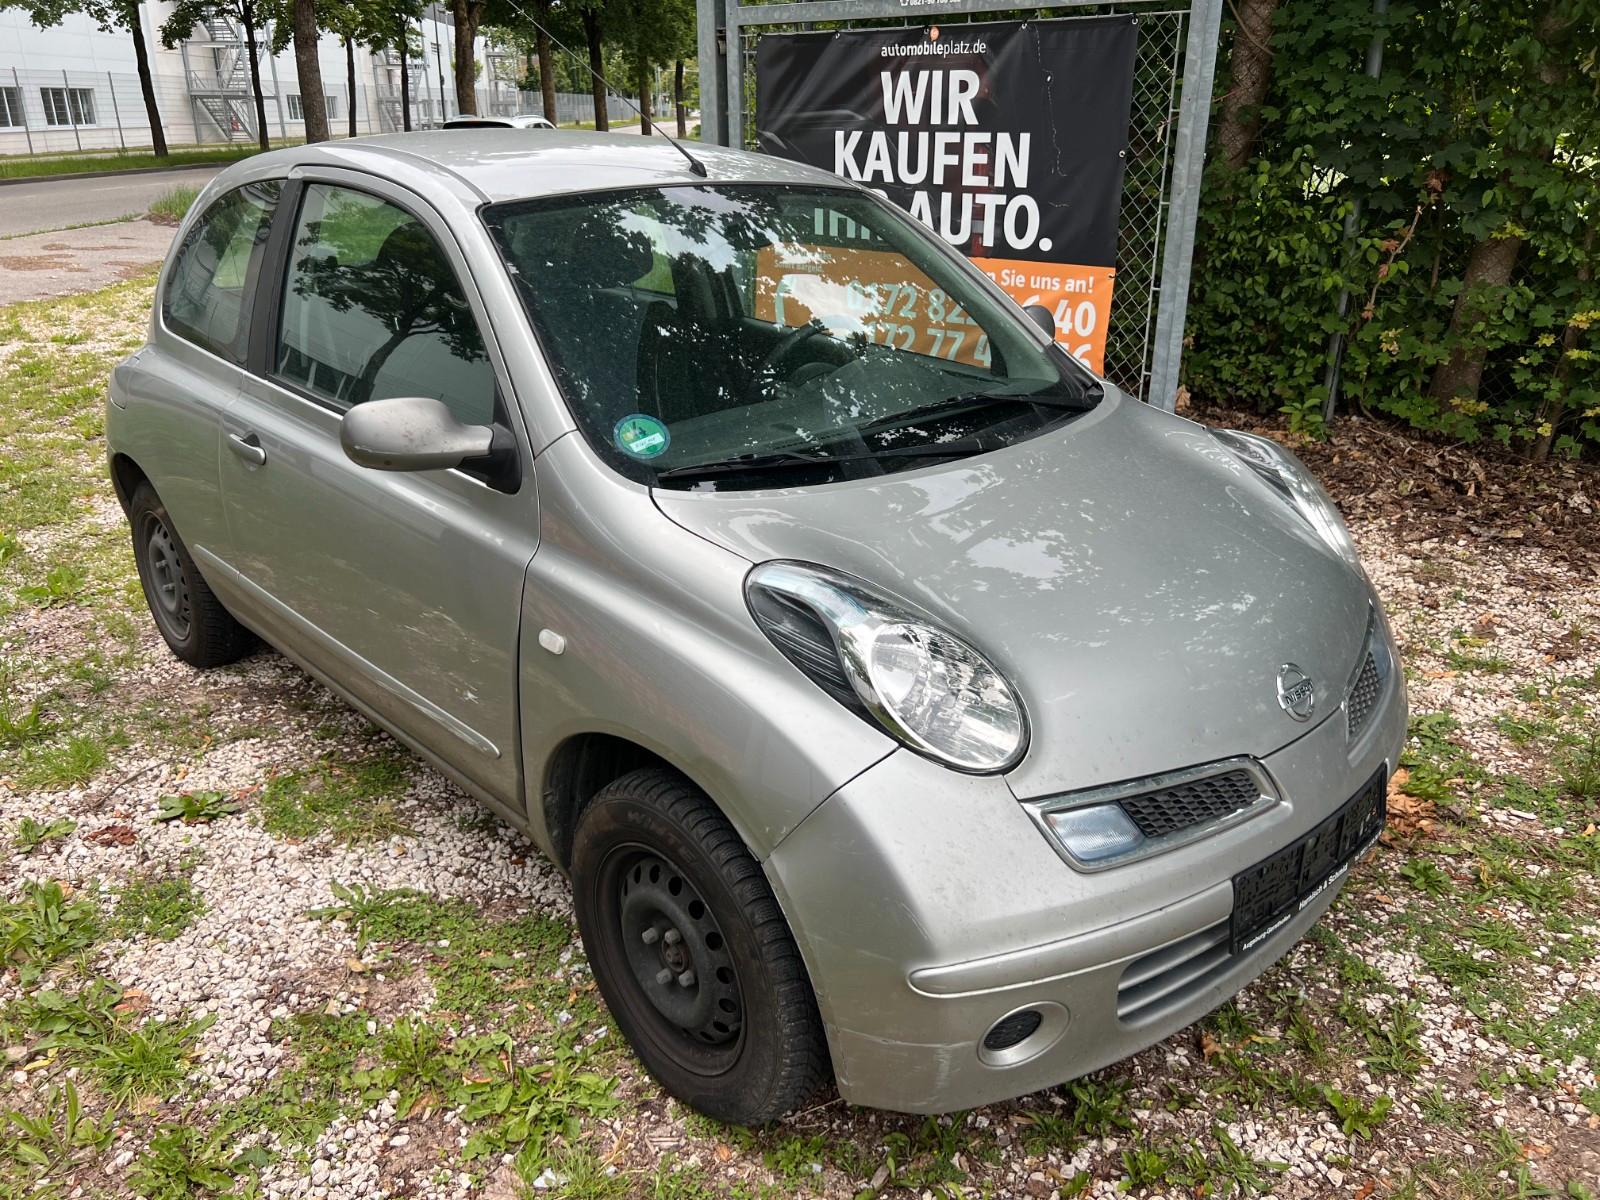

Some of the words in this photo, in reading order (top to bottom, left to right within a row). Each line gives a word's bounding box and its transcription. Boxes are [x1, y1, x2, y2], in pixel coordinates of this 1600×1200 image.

[880, 39, 987, 58] automobileplatz.de
[880, 69, 980, 126] WIR
[834, 130, 1031, 188] KAUFEN
[909, 190, 1053, 252] AUTO.
[1000, 268, 1026, 288] Sie
[1030, 275, 1060, 291] uns
[1064, 275, 1095, 294] an!
[1053, 299, 1097, 338] 40
[1285, 681, 1312, 706] NISSAN
